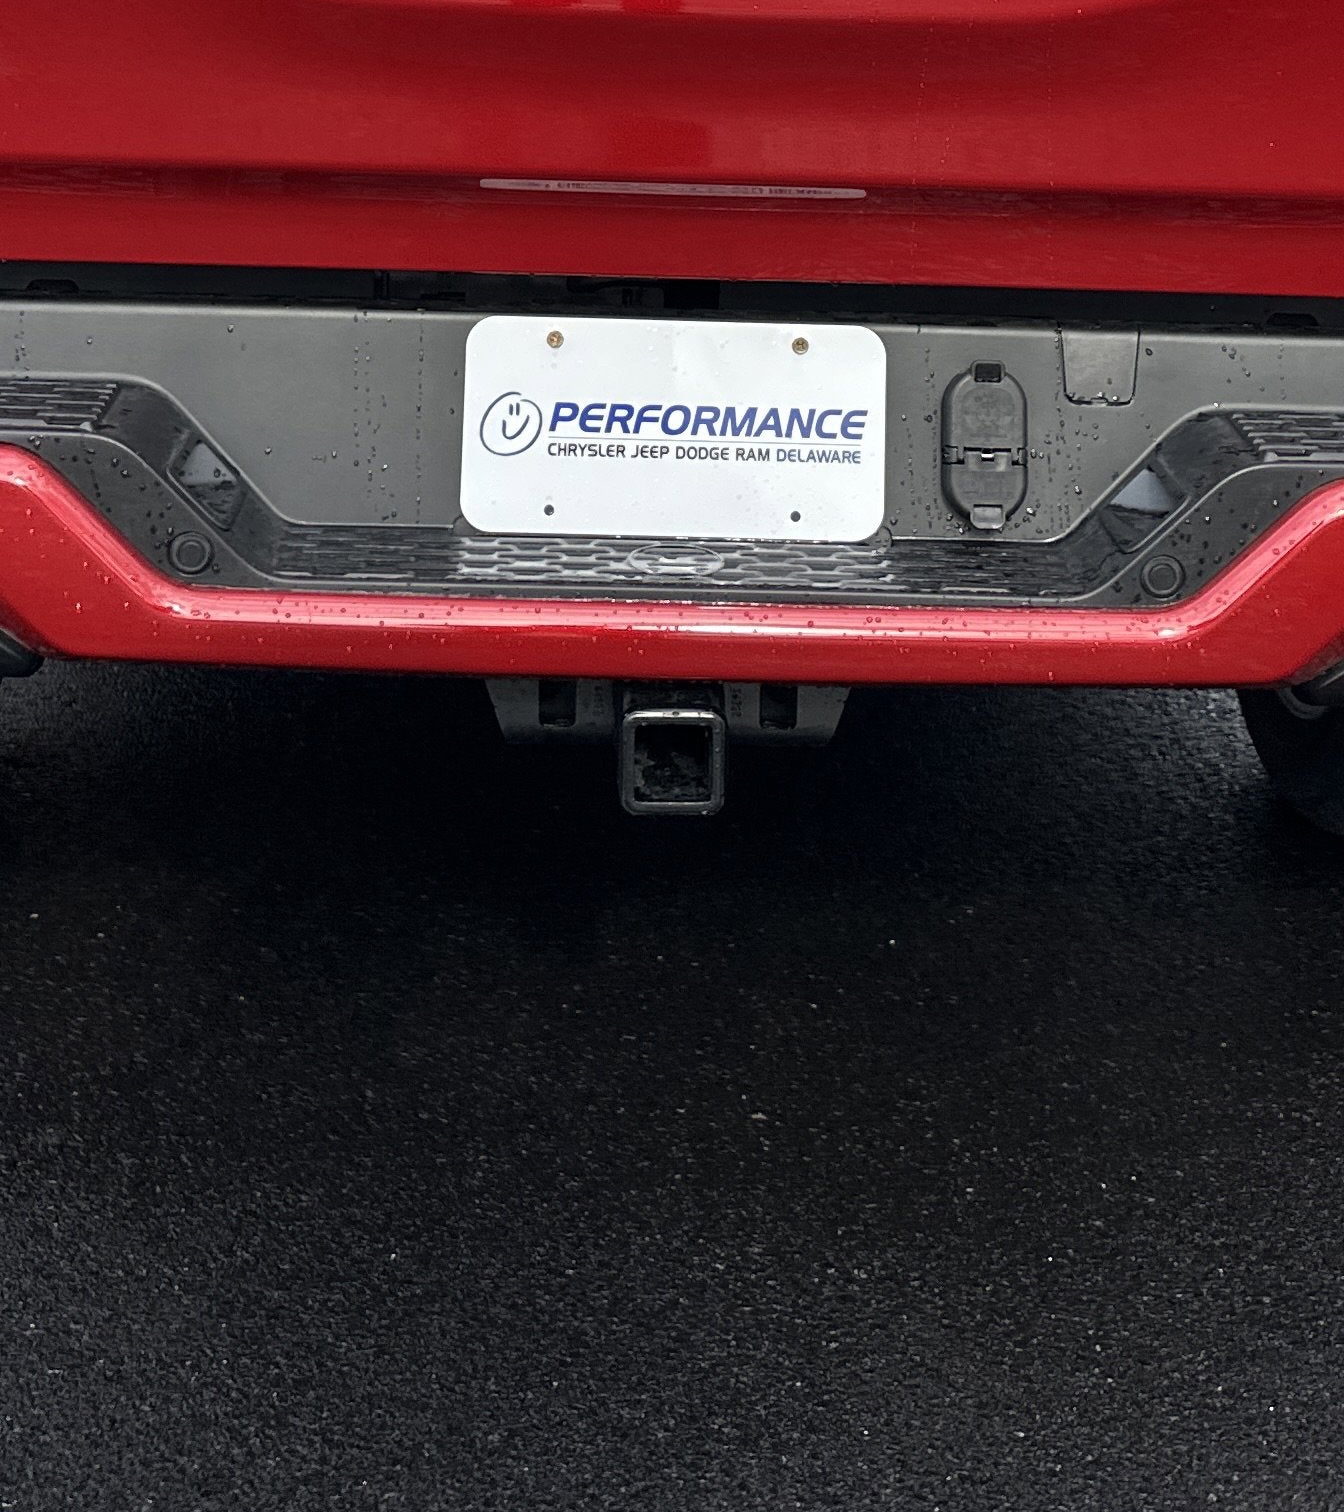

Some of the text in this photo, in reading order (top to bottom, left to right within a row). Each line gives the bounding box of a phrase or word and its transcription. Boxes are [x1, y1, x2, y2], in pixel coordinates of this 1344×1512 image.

[548, 401, 869, 441] PERFORMANCE
[547, 442, 862, 465] CHRYSLER JEEP DODGE RAM DELAWARE
